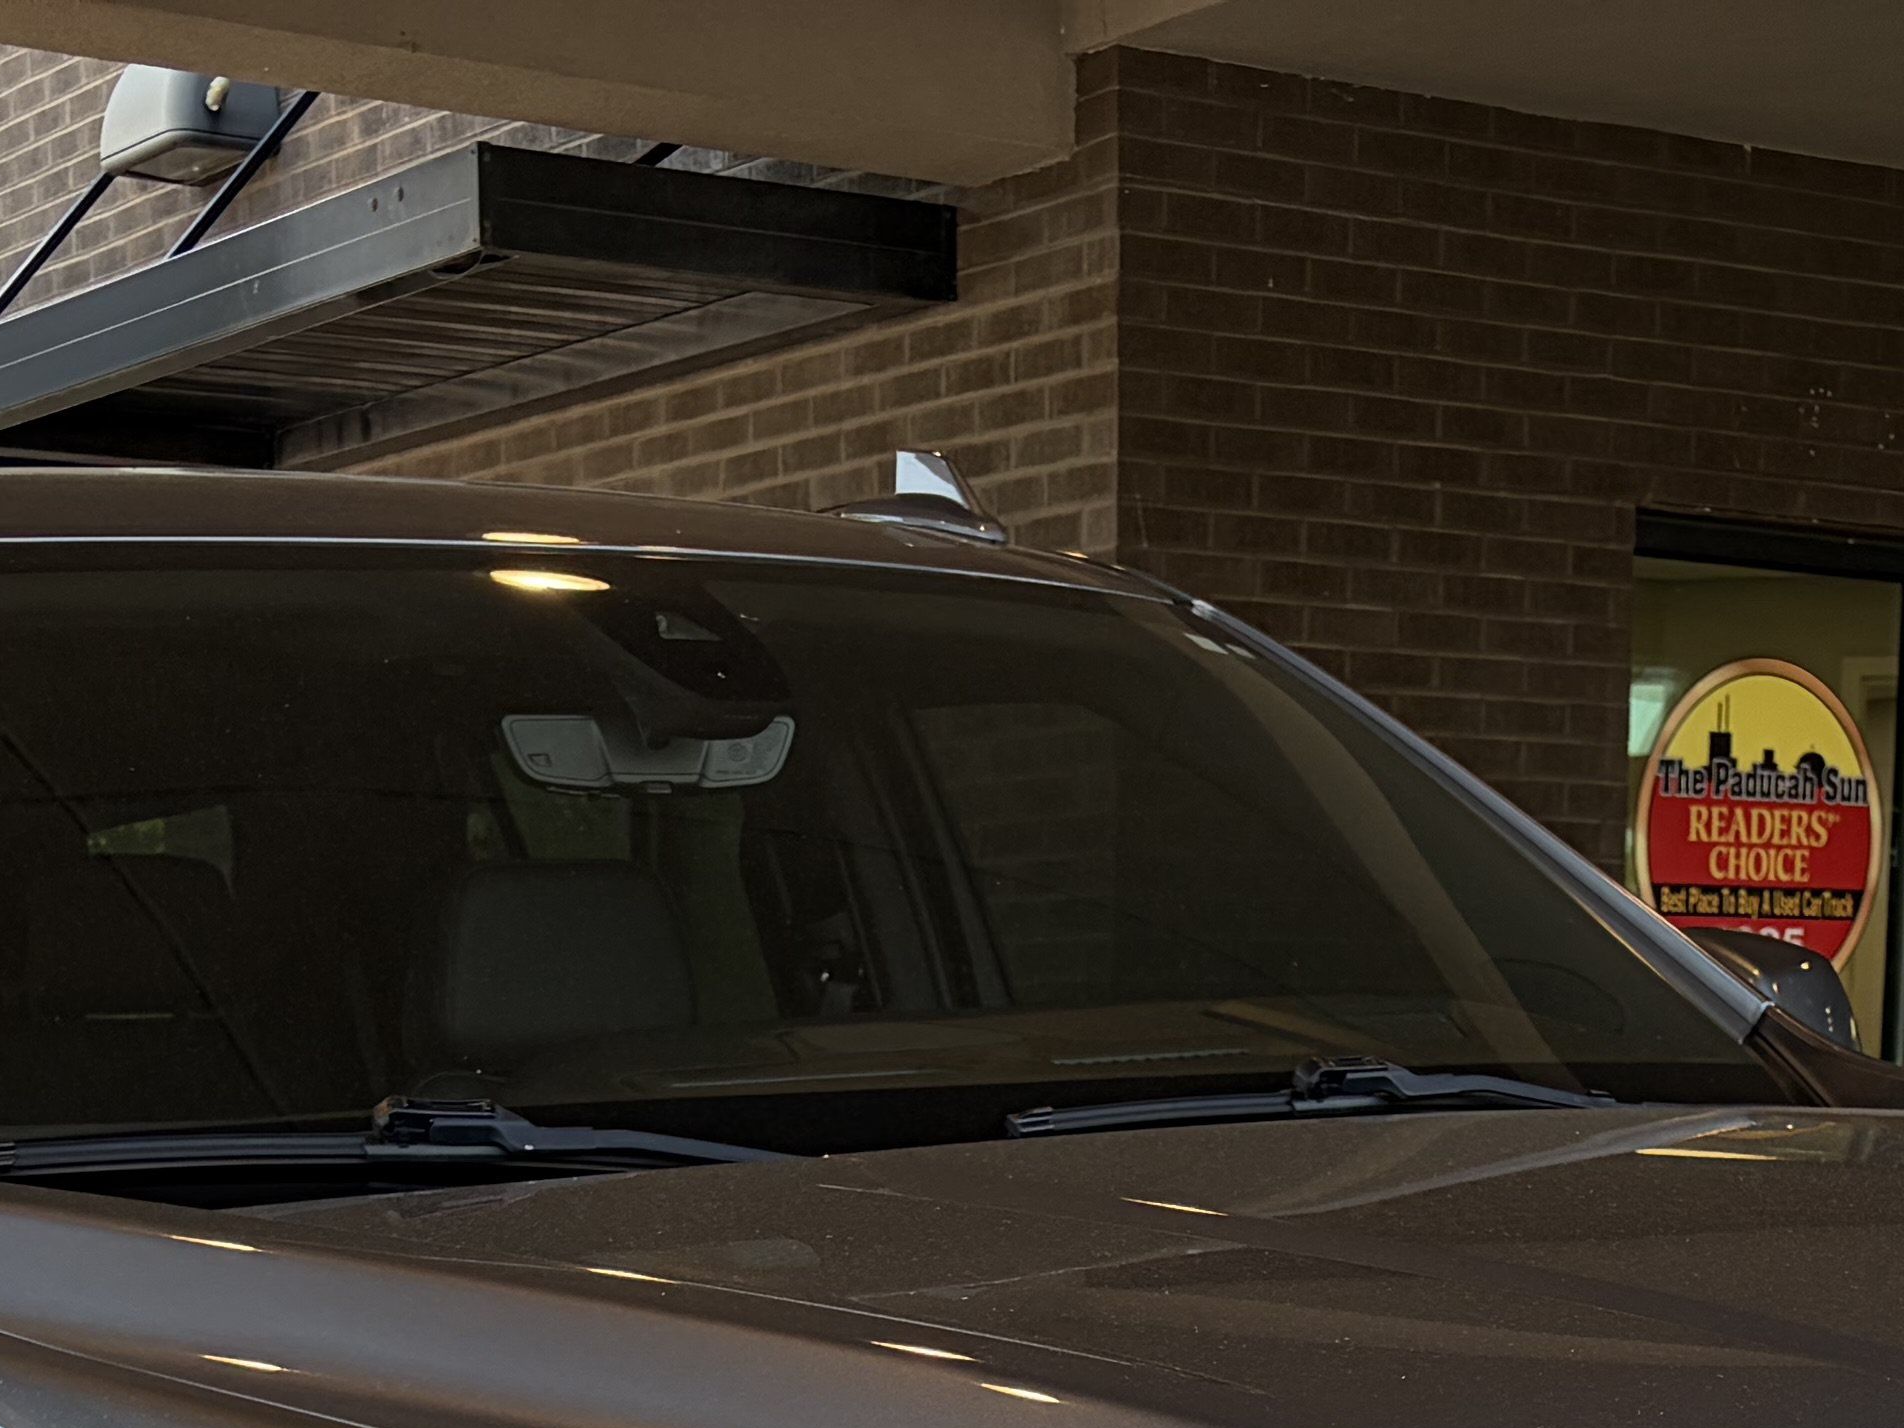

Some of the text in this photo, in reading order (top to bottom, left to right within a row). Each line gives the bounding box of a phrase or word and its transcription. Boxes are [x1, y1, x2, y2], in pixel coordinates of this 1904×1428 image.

[1658, 757, 1869, 805] The Paducah Sun
[1708, 846, 1810, 882] CHOICE
[1660, 886, 1687, 912] Best
[1689, 887, 1720, 914] Place
[1738, 889, 1760, 918] Buy
[1761, 889, 1771, 915] A
[1773, 889, 1800, 916] Used
